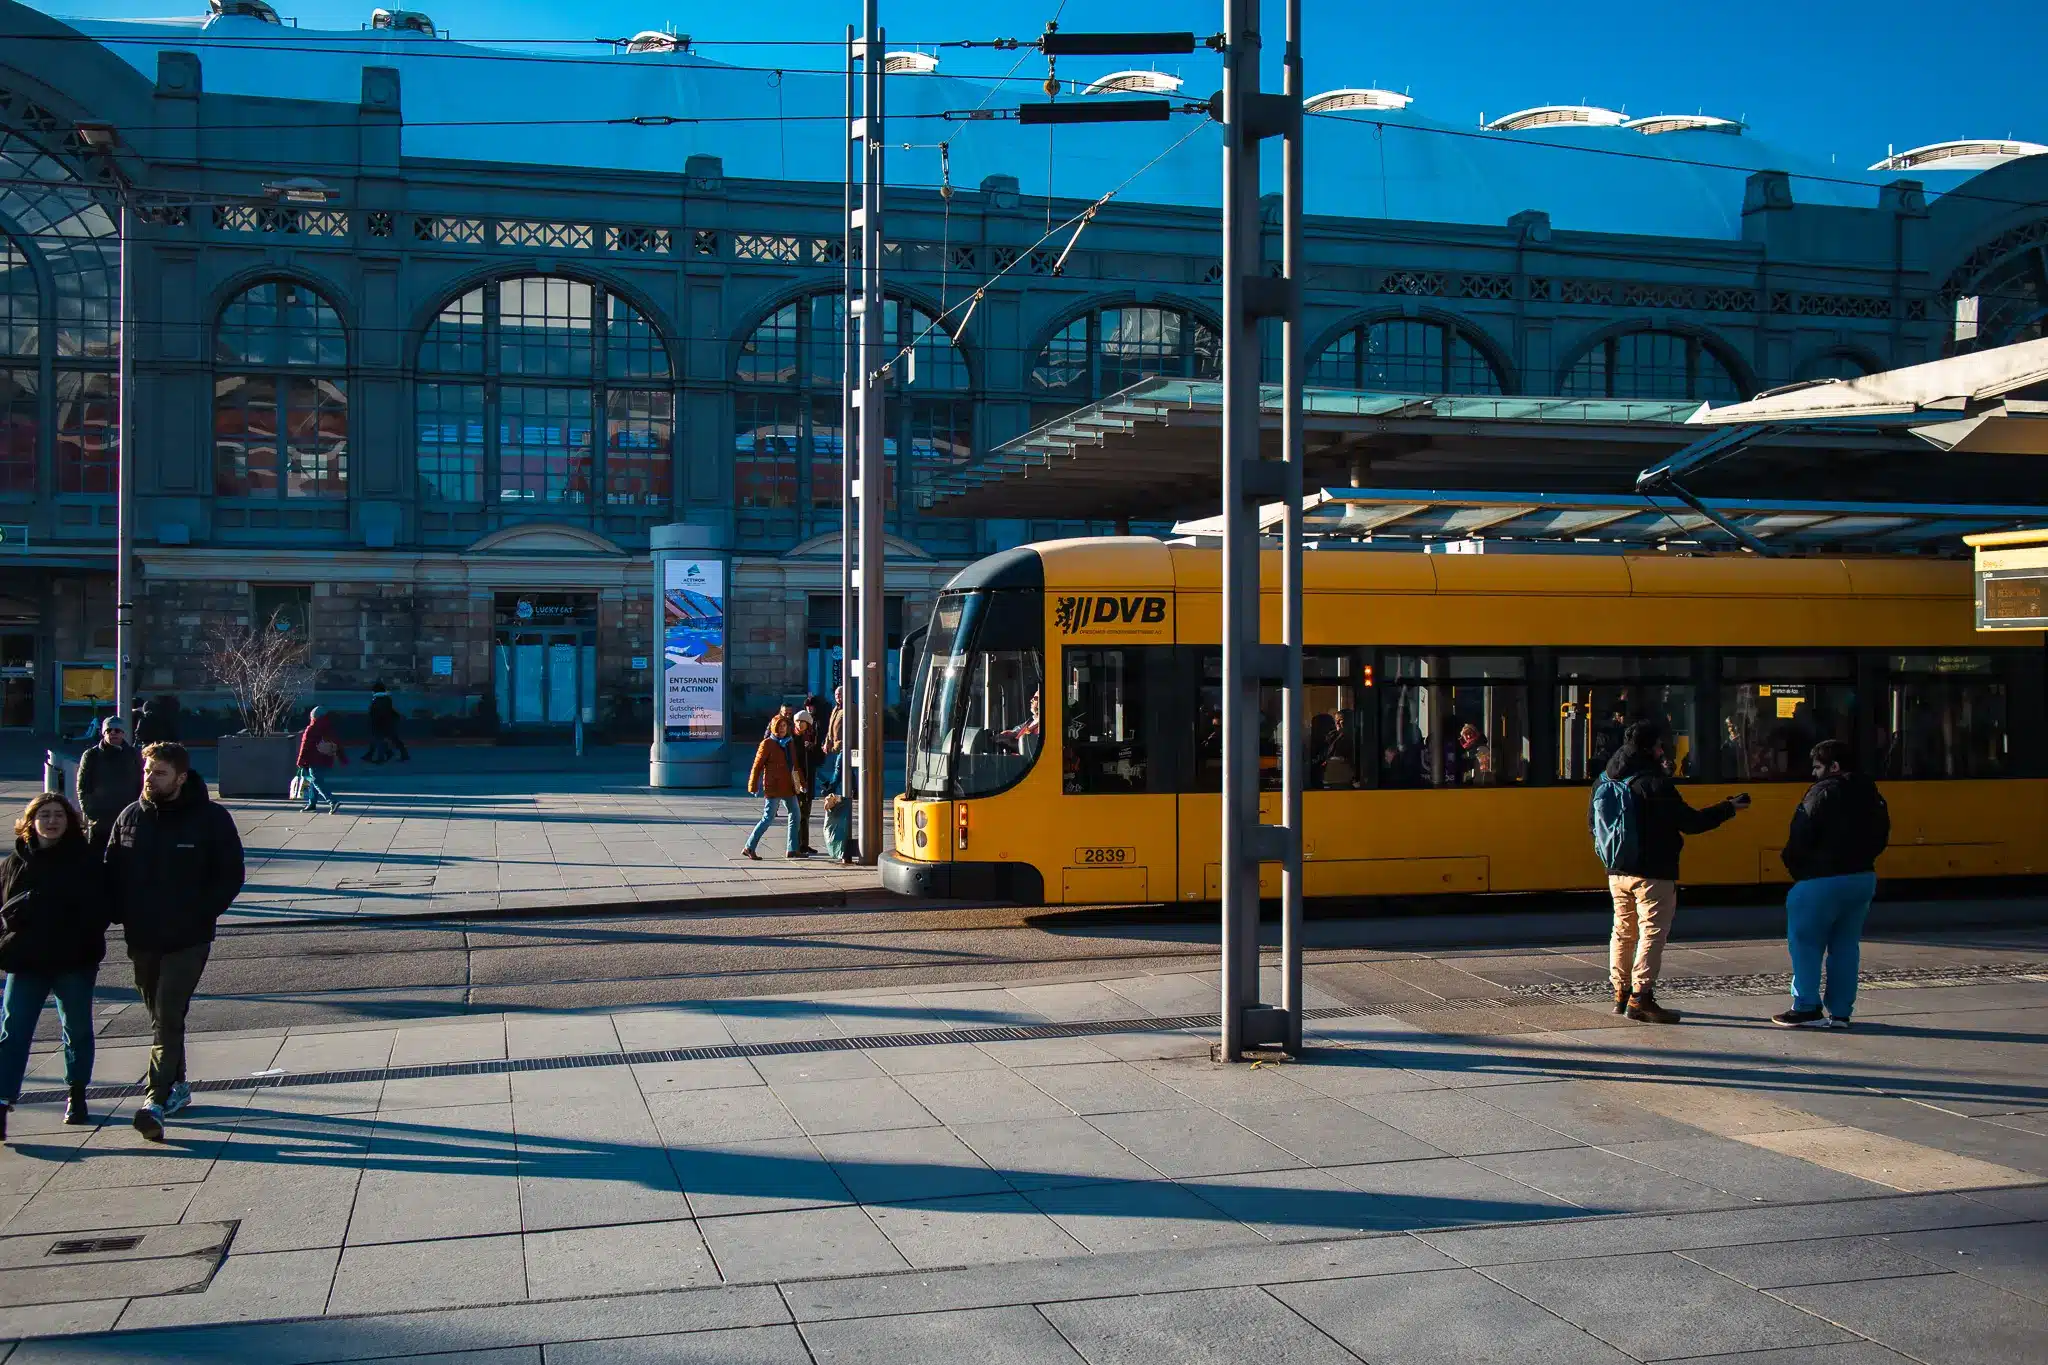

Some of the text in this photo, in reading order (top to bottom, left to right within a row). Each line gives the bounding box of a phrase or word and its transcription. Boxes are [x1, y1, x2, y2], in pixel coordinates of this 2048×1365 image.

[535, 606, 574, 614] LUCKY CAT
[1093, 597, 1167, 623] DVB
[1085, 849, 1126, 863] 2839
